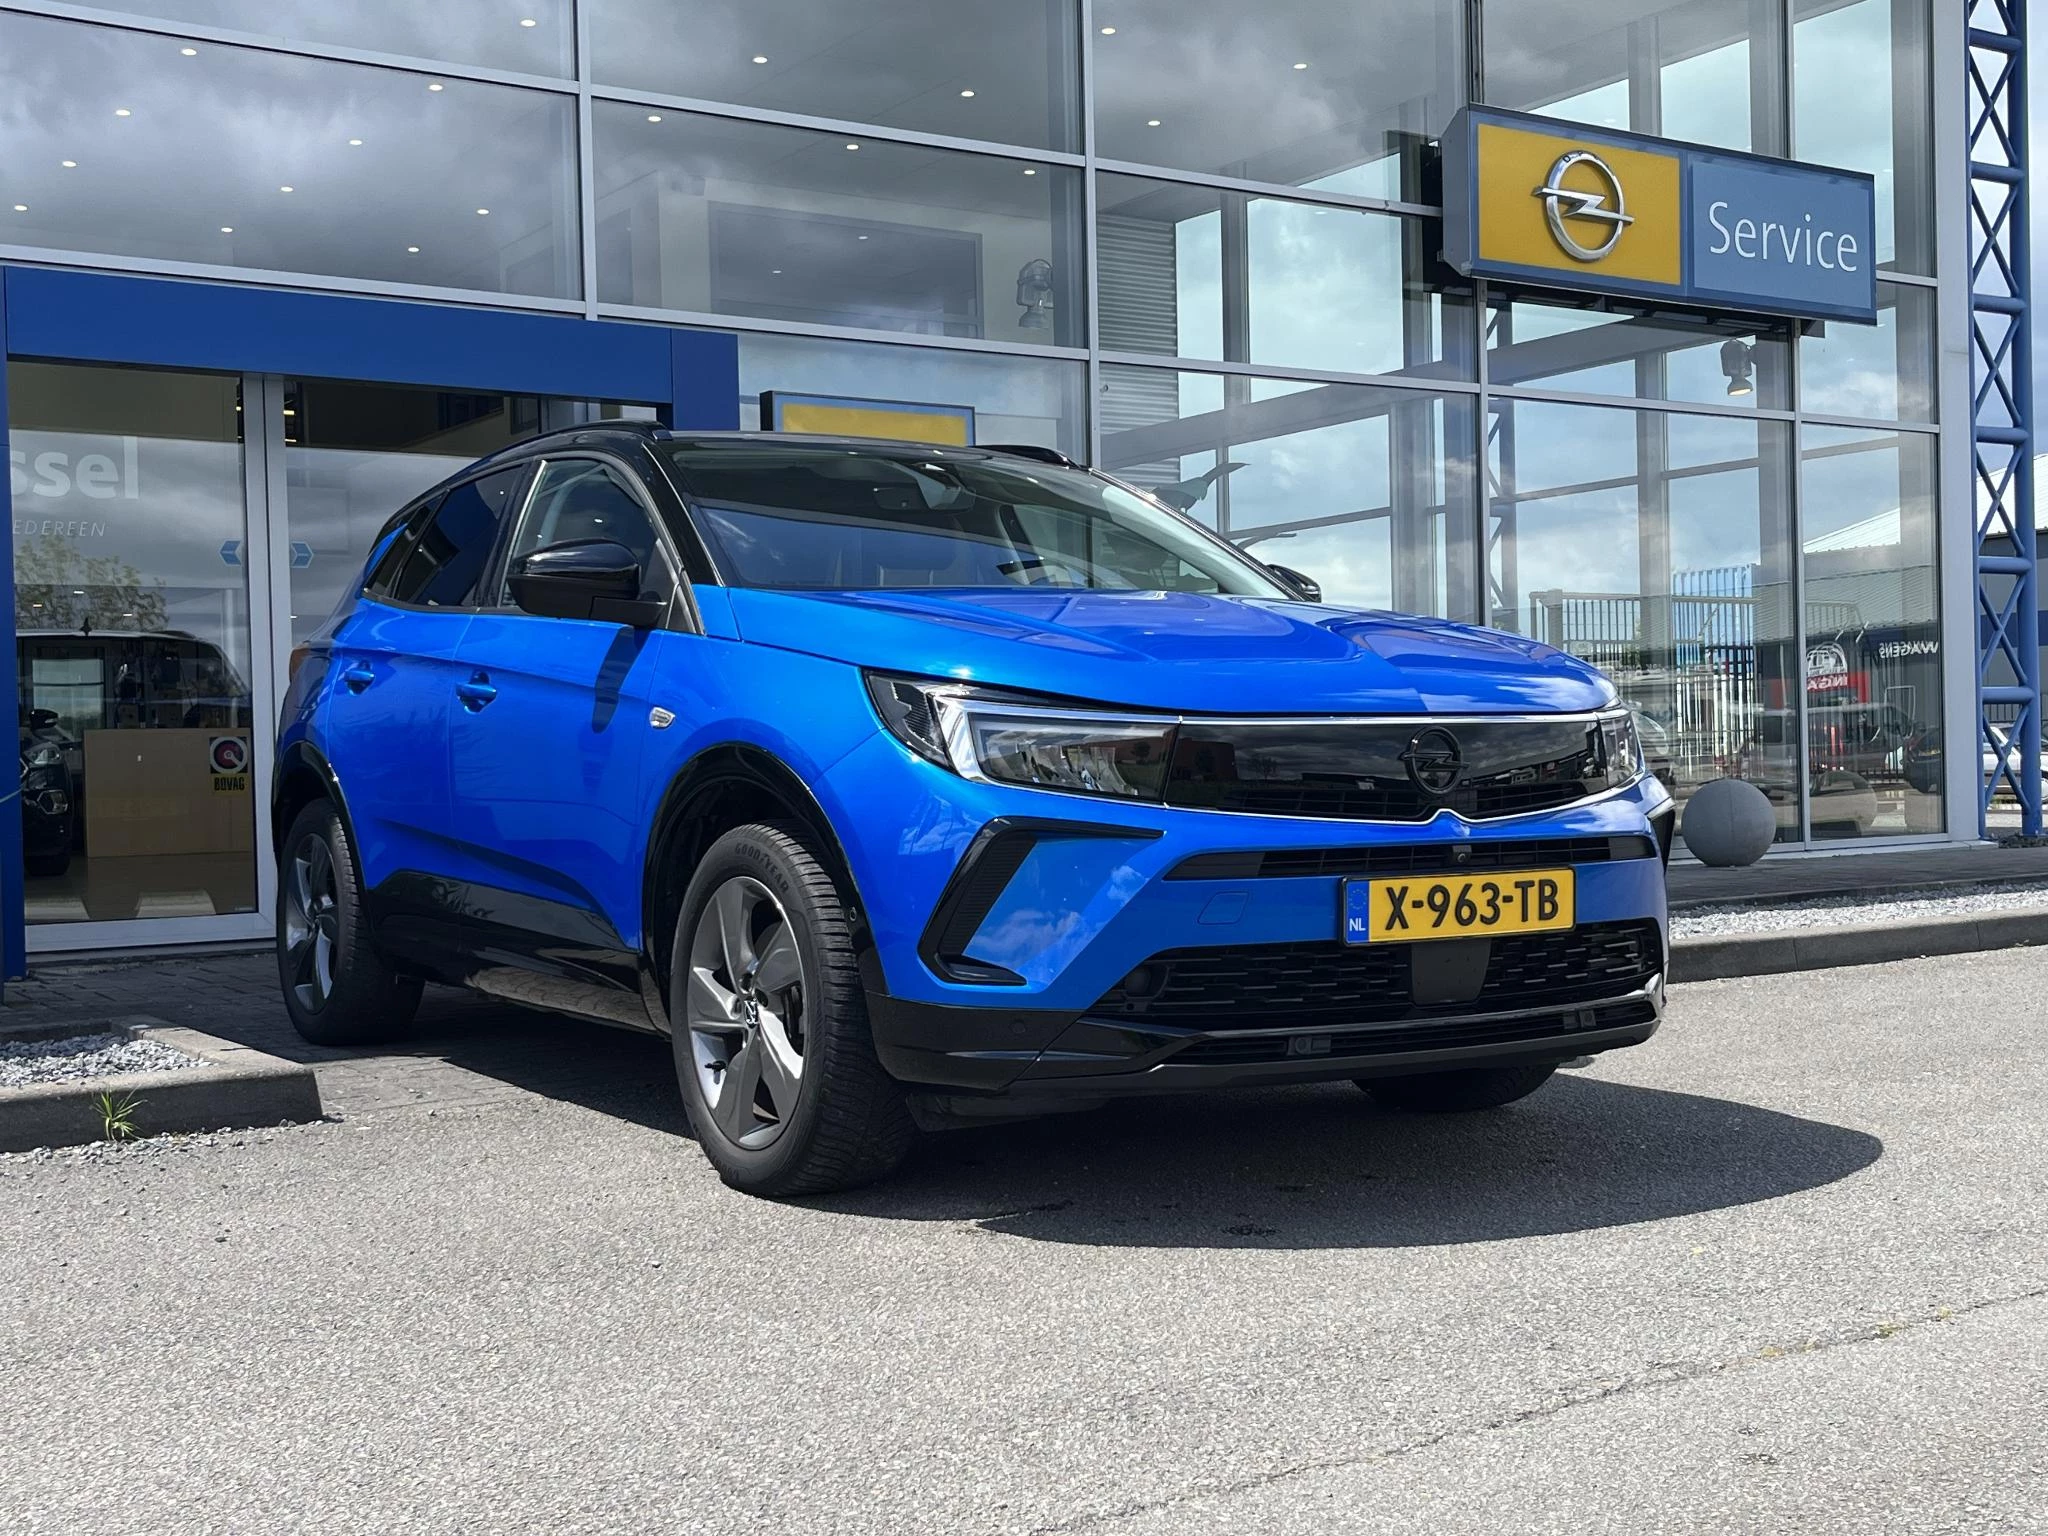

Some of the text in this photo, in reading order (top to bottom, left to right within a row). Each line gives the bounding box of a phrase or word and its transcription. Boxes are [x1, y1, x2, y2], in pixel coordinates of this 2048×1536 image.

[1709, 201, 1858, 272] Service
[214, 776, 246, 791] BOVAG
[735, 842, 789, 893] GOODYEAR
[1349, 917, 1366, 932] NL
[1385, 879, 1559, 931] X-963-TB
